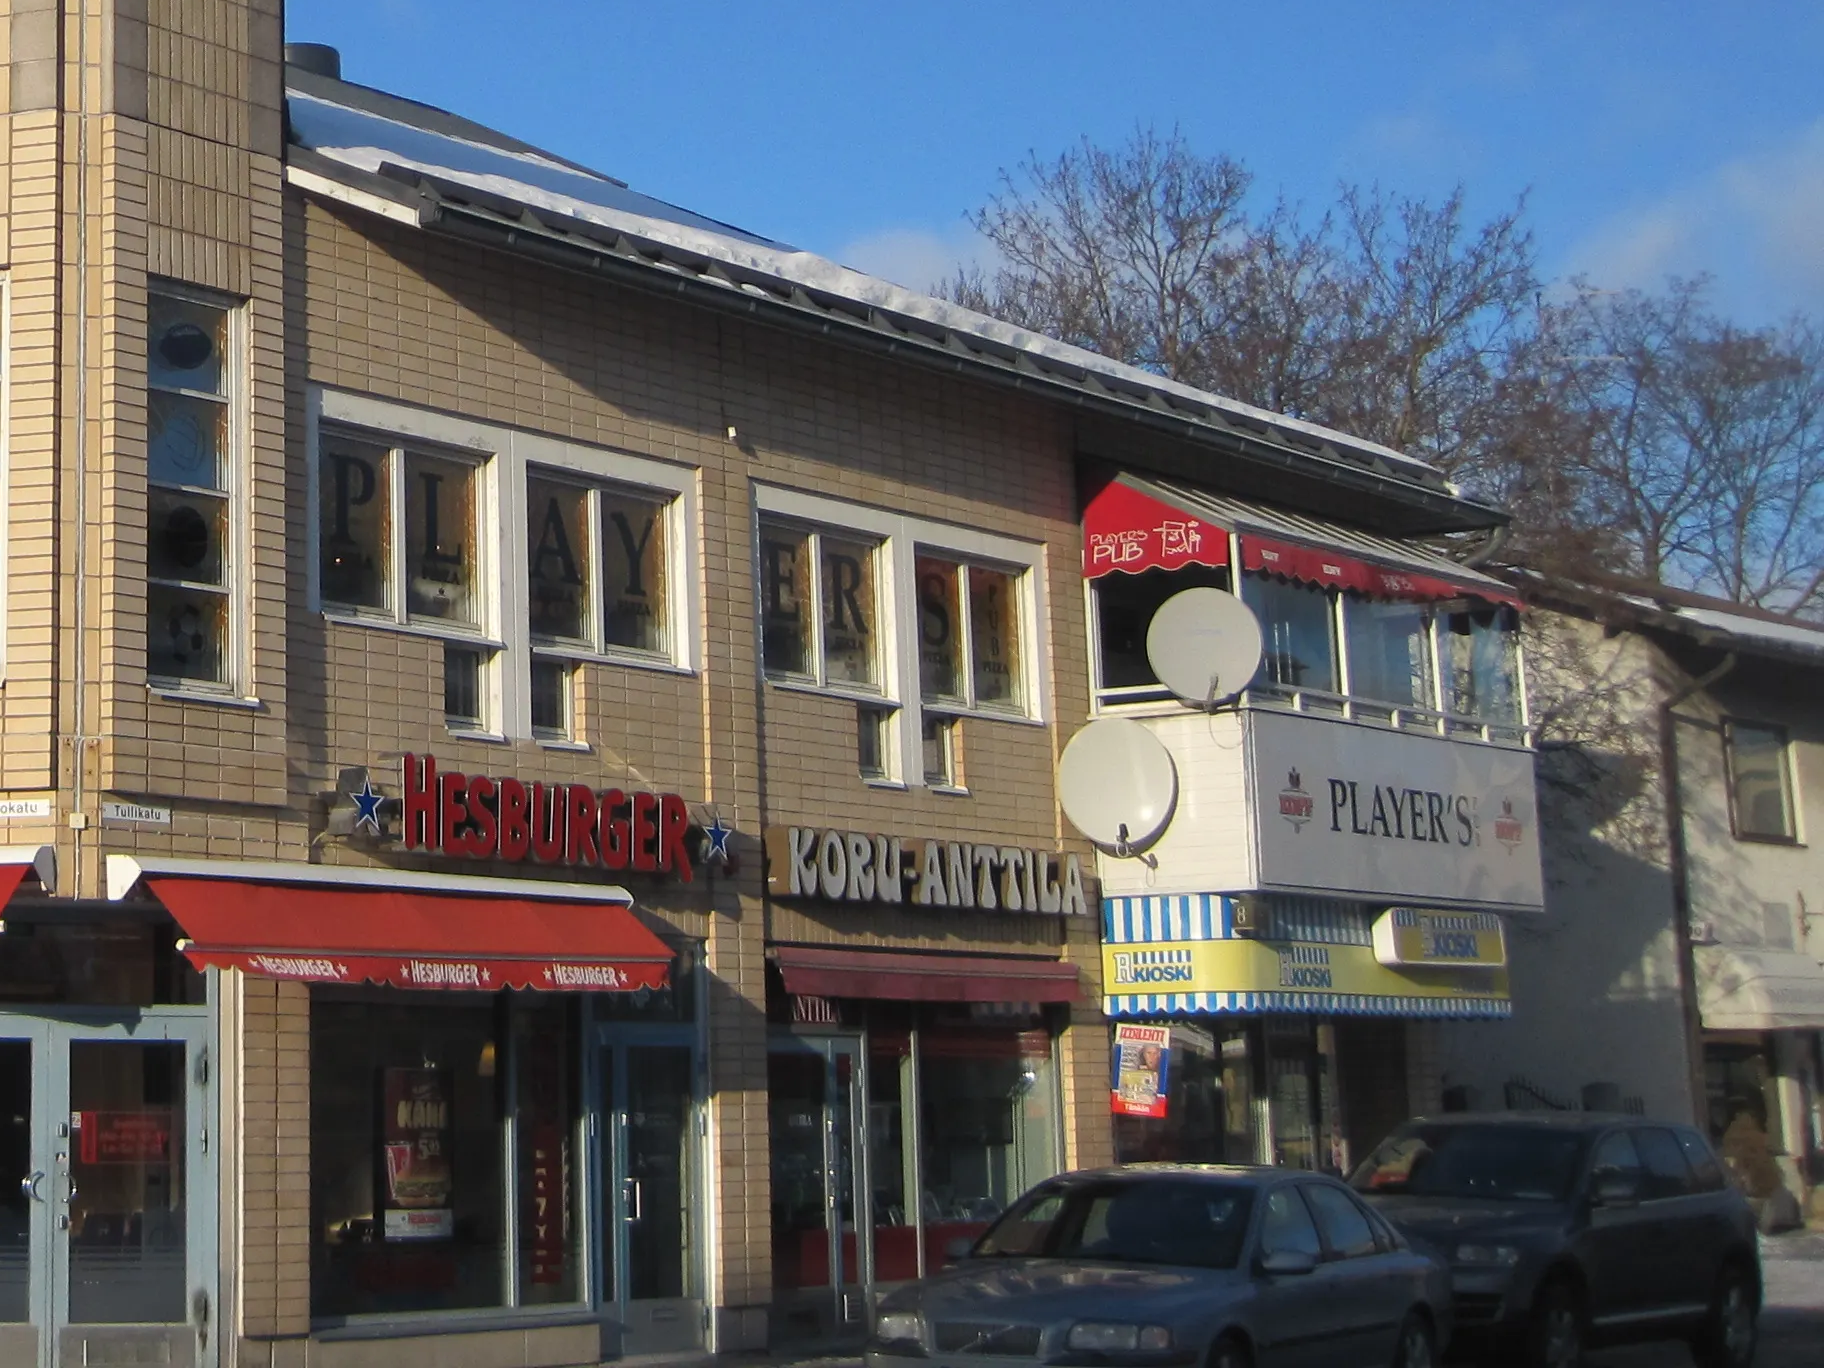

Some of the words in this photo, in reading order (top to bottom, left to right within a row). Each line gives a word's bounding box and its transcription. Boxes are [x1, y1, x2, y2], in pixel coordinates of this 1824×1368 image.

[1093, 544, 1144, 565] PUB
[112, 804, 161, 821] Tullikatu
[402, 752, 693, 883] HESBURGER
[1327, 777, 1473, 847] PLAYER'S
[788, 826, 1088, 916] KORU-ANTTILA
[1433, 931, 1480, 958] KIOSKI
[257, 955, 340, 979] HESBURGER
[410, 960, 480, 986] HESBURGER
[552, 963, 620, 988] HESBURGER
[1133, 964, 1193, 982] KIOSKI
[1291, 968, 1332, 988] KIOSKI
